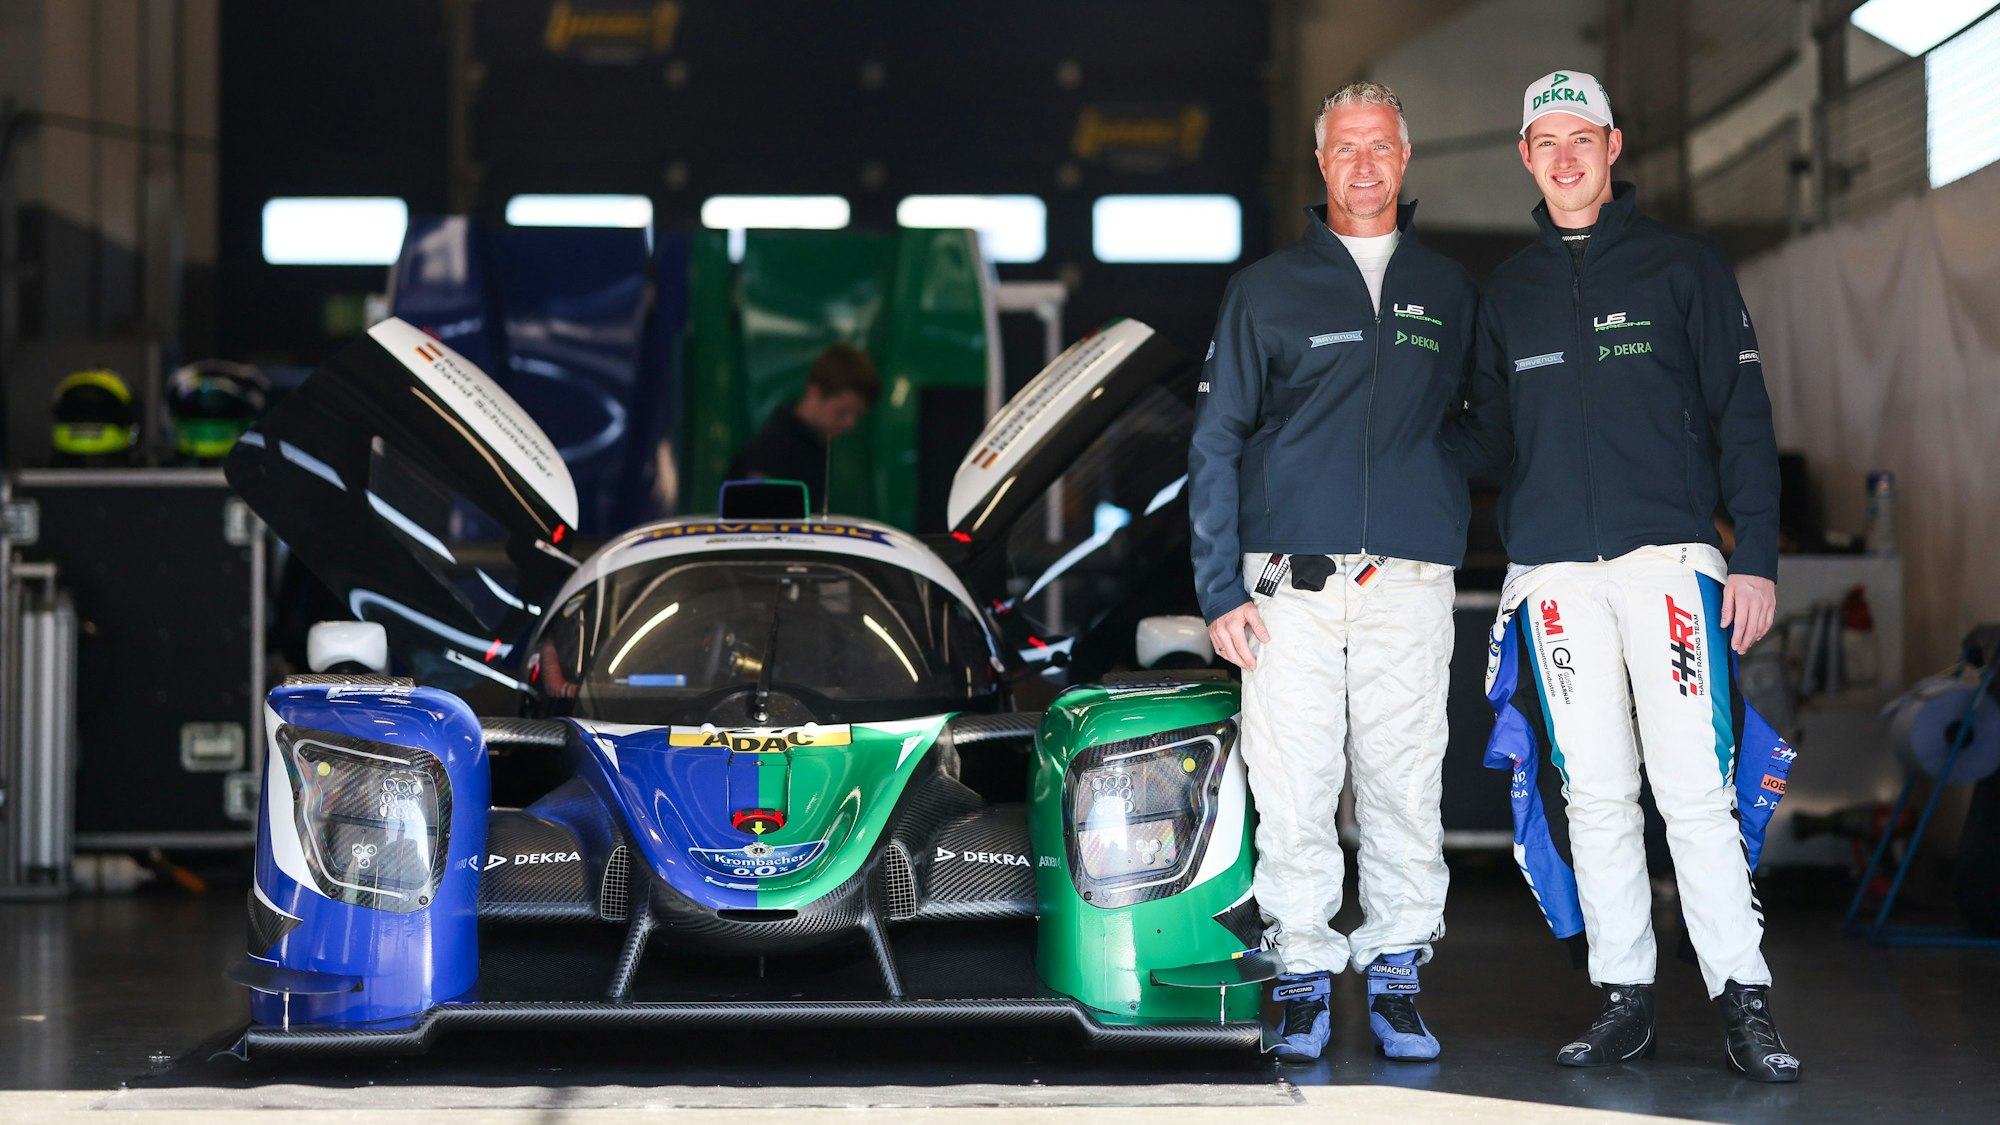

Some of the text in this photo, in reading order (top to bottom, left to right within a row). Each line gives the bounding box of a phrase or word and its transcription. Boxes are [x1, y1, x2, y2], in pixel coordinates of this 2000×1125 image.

[1533, 88, 1588, 111] DEKRA
[1395, 312, 1442, 326] RACING
[1595, 320, 1651, 332] RACING
[1315, 333, 1359, 344] RAVENOL
[1411, 334, 1440, 353] DEKRA
[1613, 341, 1653, 356] DEKRA
[1519, 355, 1559, 368] RAVENOL
[652, 523, 874, 539] RAVENOL
[1540, 599, 1565, 636] 3M
[1535, 621, 1556, 697] Premiumpartner Industrie
[1558, 673, 1571, 705] SCHARNAU
[703, 731, 815, 752] ADAC
[514, 851, 582, 865] DEKRA
[714, 853, 806, 866] Krombacher
[963, 851, 1031, 867] DEKRA
[1288, 986, 1313, 994] RACING
